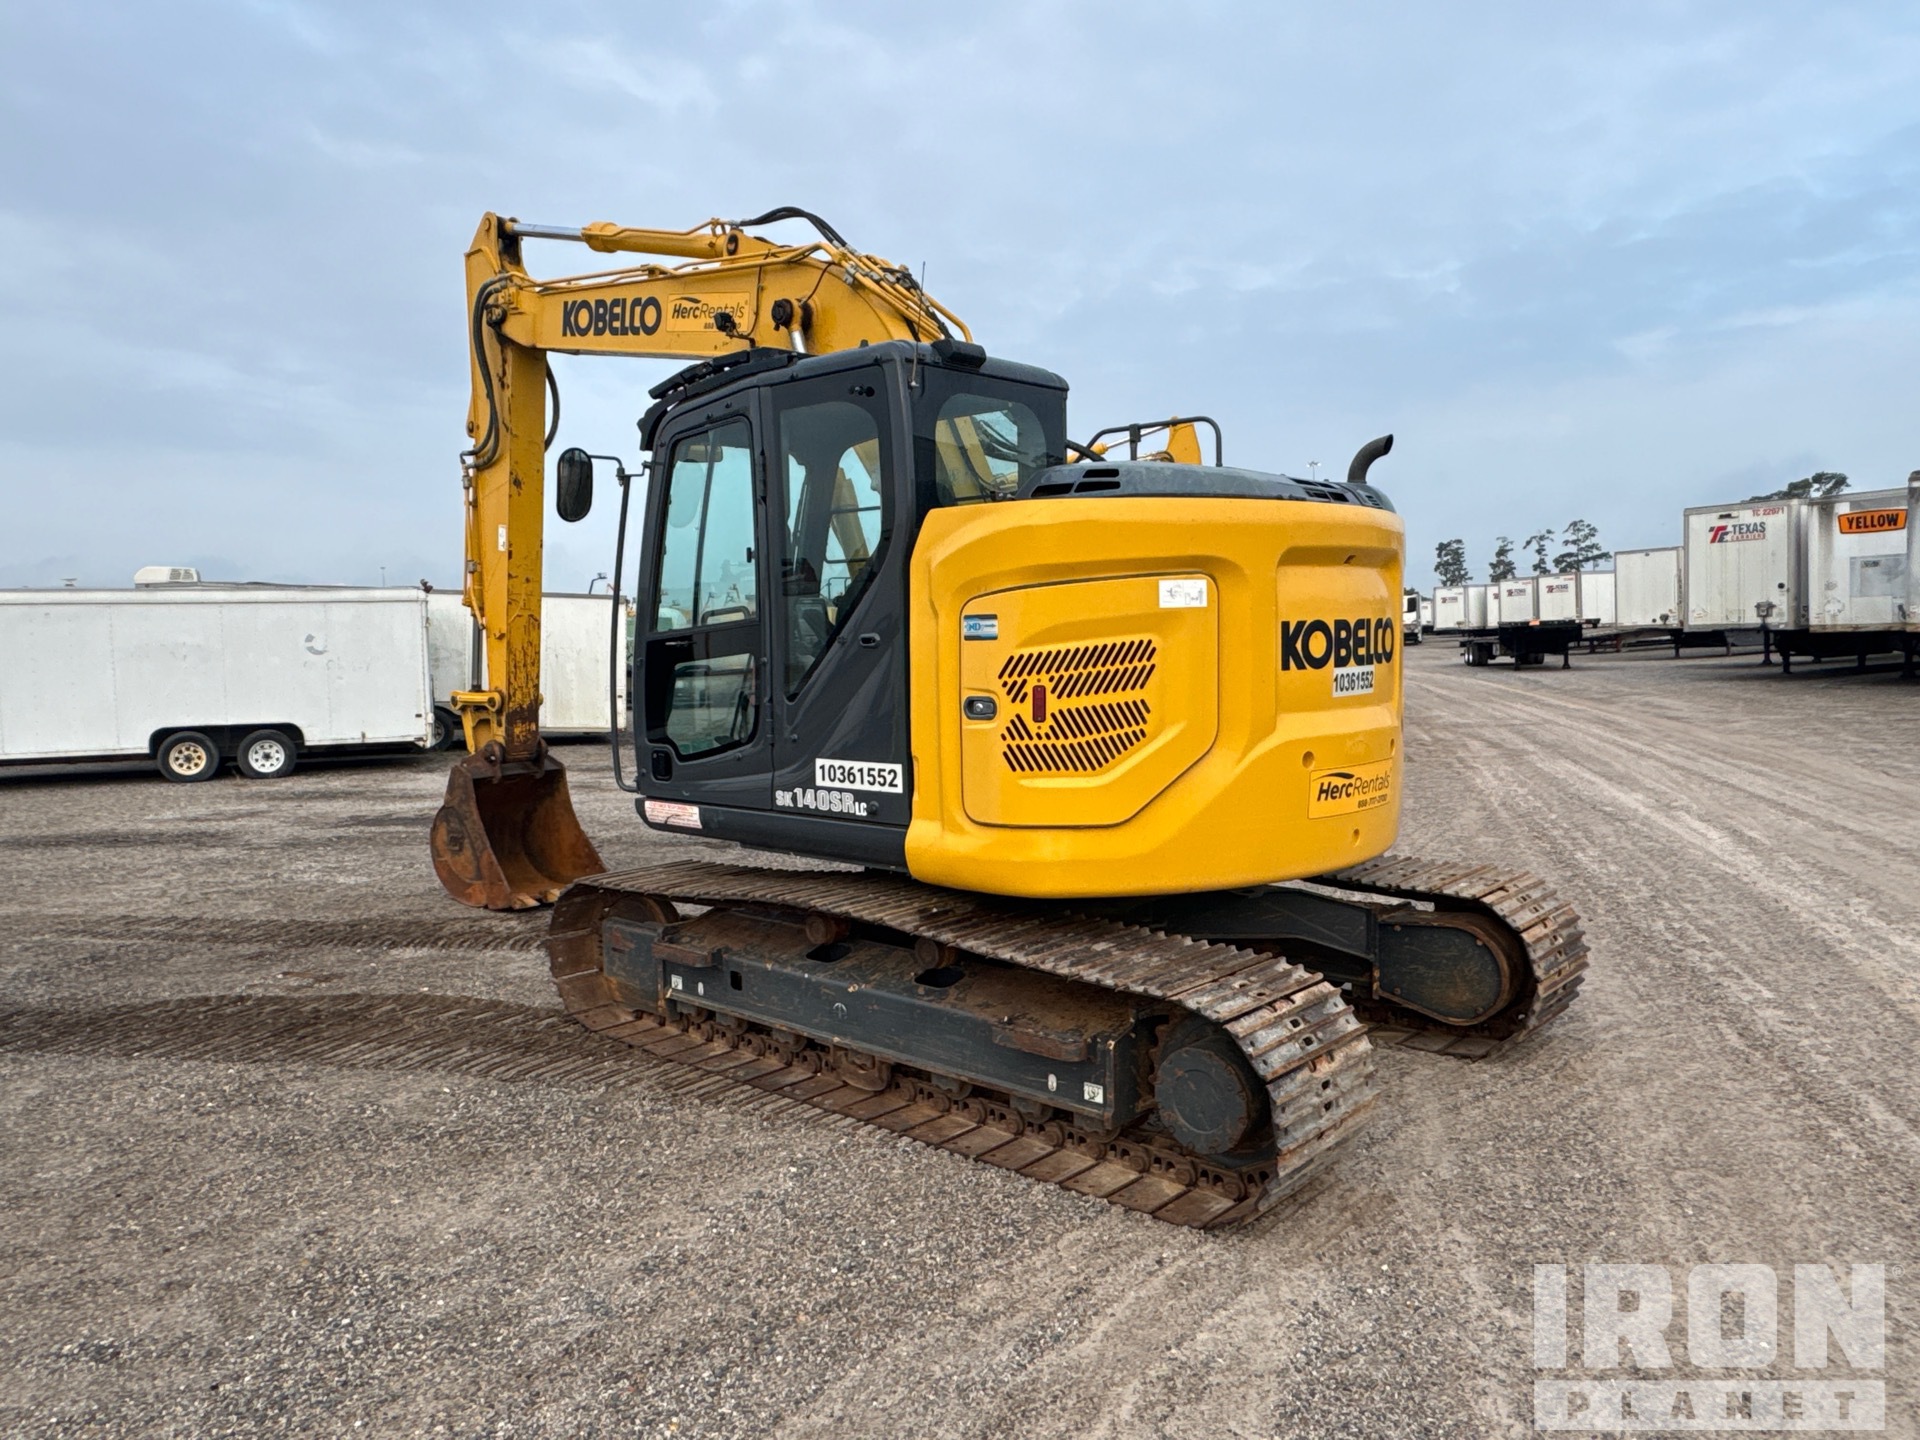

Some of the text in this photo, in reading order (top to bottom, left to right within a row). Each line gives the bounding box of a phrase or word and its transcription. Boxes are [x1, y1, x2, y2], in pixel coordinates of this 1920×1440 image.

[562, 296, 662, 337] KOBELCO
[1732, 522, 1766, 534] TEXAS
[1847, 513, 1899, 529] YELLOW
[1281, 617, 1394, 671] KOBELCO
[1333, 671, 1374, 692] 10361552
[819, 764, 898, 788] 10361552
[1317, 770, 1391, 802] HercRentals
